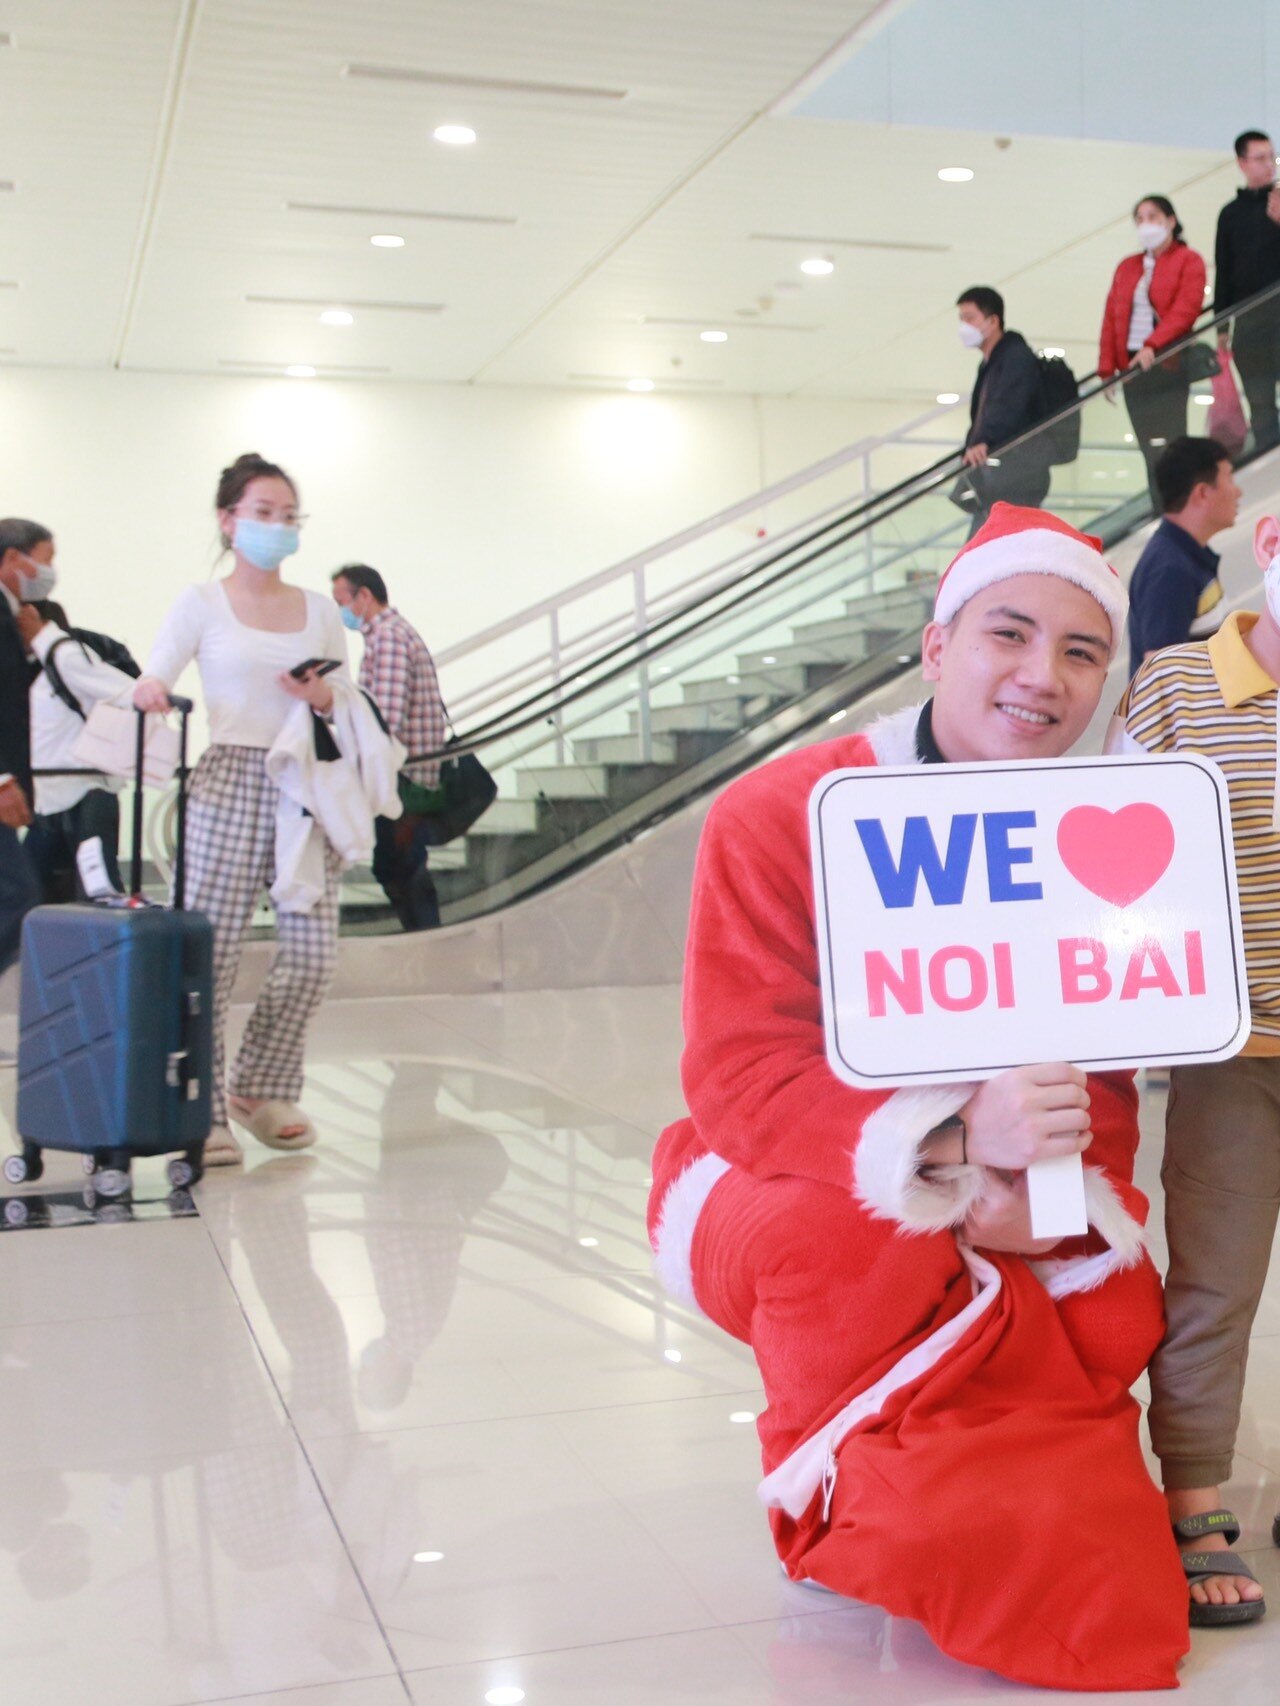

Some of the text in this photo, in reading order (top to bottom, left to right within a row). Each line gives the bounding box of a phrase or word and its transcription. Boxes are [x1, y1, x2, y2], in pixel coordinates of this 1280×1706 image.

[854, 810, 1044, 909] WE
[863, 930, 1207, 1018] NOI BAI
